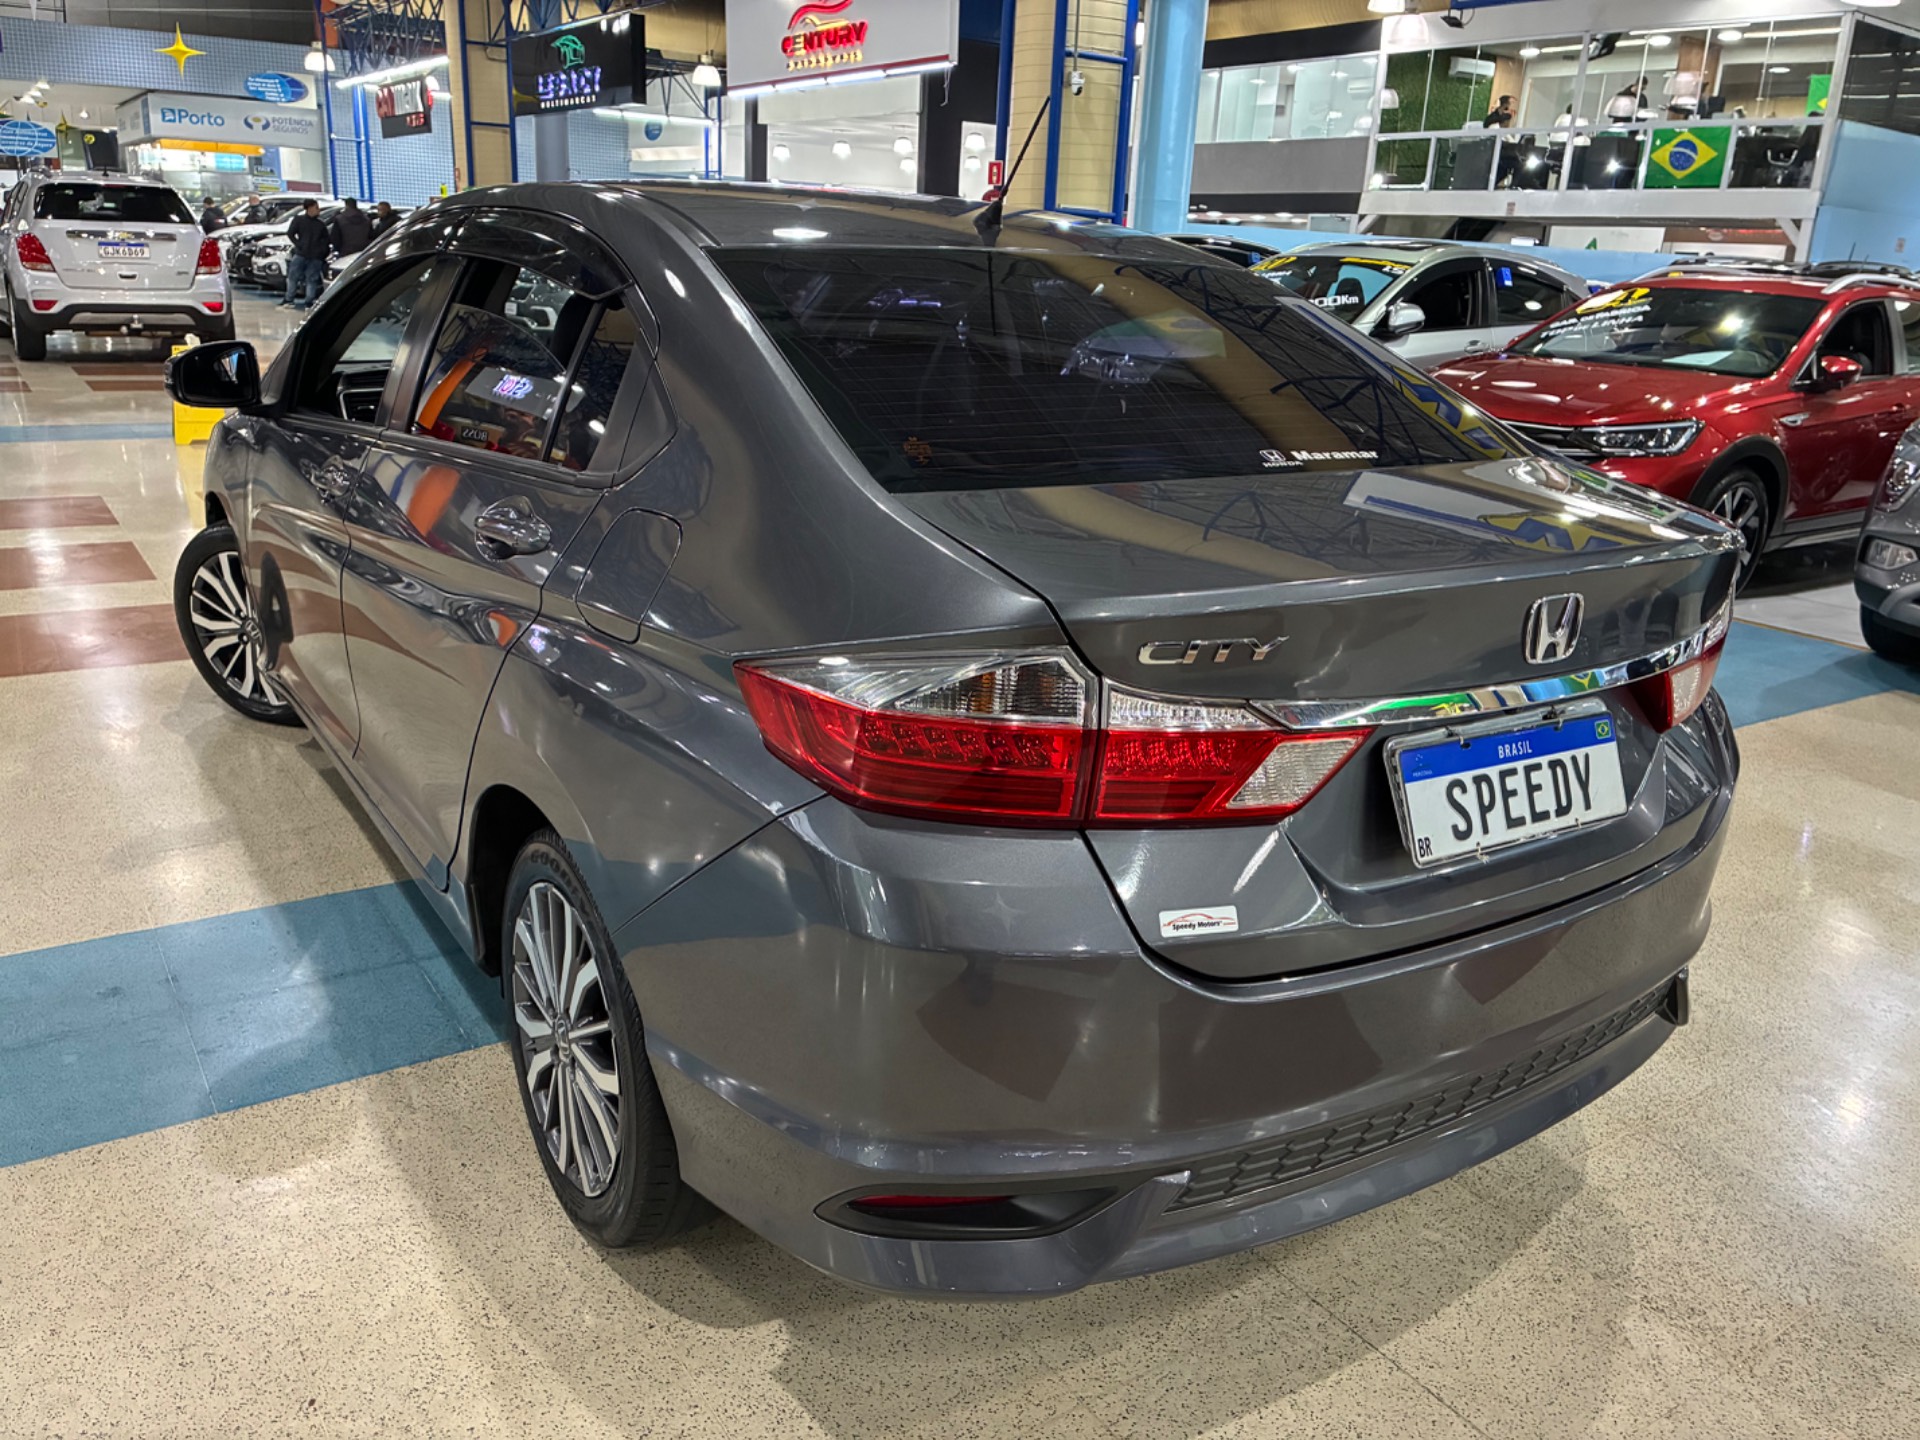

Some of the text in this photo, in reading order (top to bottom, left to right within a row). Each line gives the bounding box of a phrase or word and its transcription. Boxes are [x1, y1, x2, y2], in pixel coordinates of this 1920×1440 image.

[781, 20, 868, 57] CENTURY
[178, 108, 225, 127] Porto
[1262, 460, 1304, 468] HONDA
[1290, 449, 1379, 461] Maramar
[1138, 635, 1290, 664] CITY
[1497, 740, 1533, 759] BRASIL
[1446, 752, 1592, 841] SPEEDY
[1417, 837, 1433, 858] BR
[1172, 922, 1196, 932] Speedy
